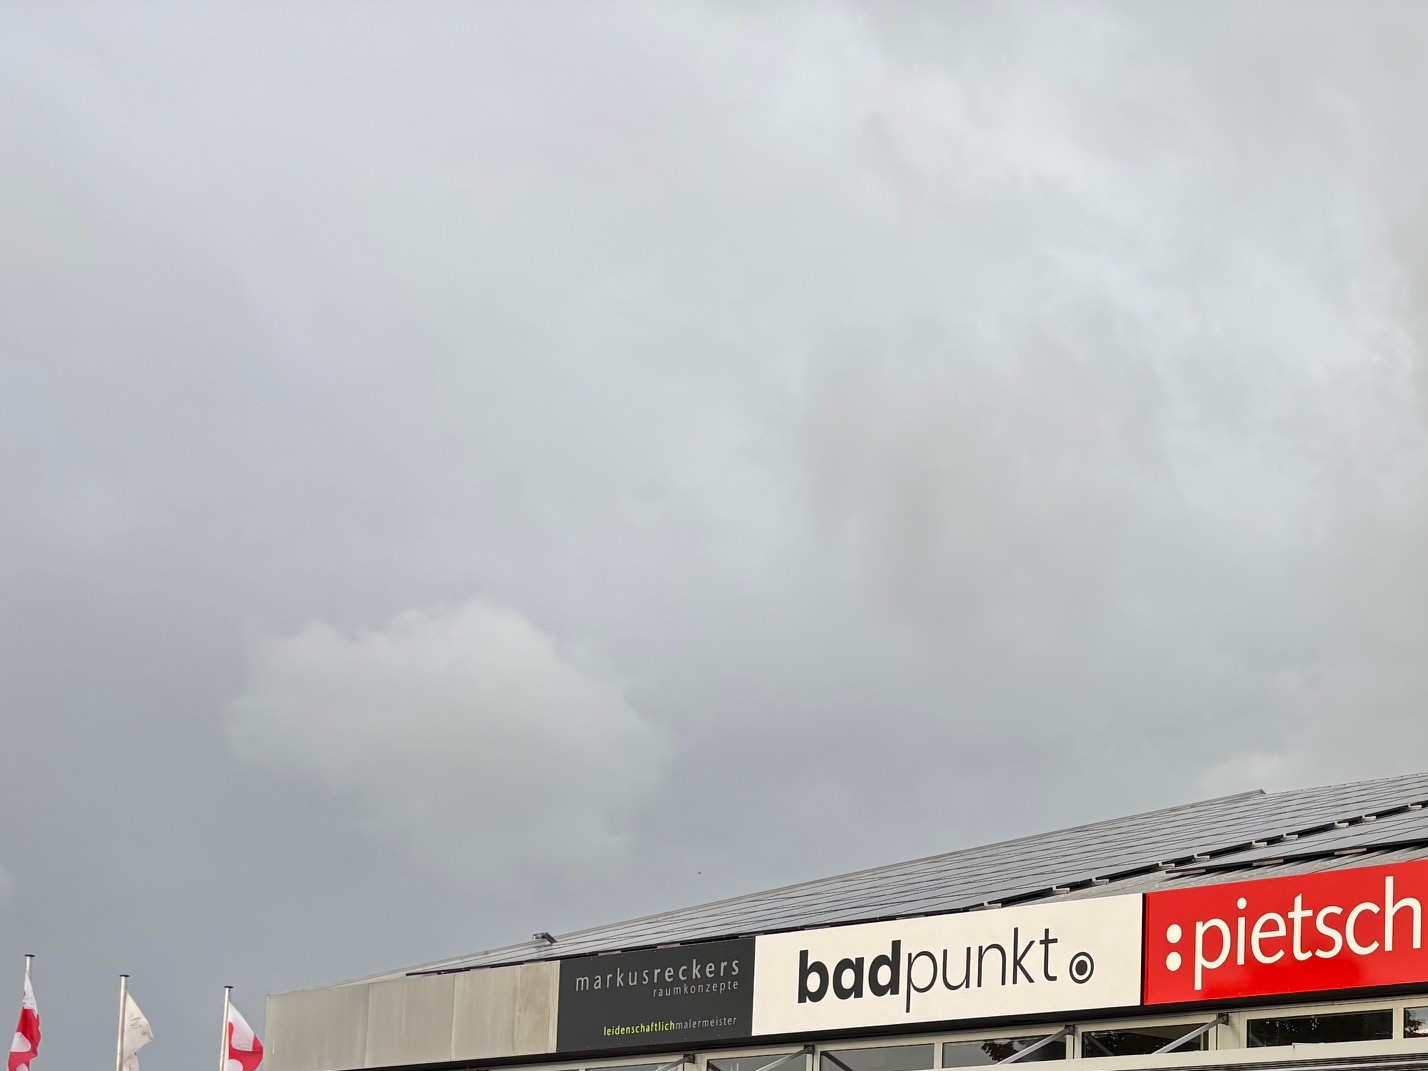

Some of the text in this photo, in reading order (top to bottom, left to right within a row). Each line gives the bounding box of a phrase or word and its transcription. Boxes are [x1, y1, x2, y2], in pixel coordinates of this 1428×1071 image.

[575, 958, 740, 992] markusreckers
[653, 979, 739, 998] raumkonzepte
[603, 1016, 737, 1037] leidenschaftlichmalermeister
